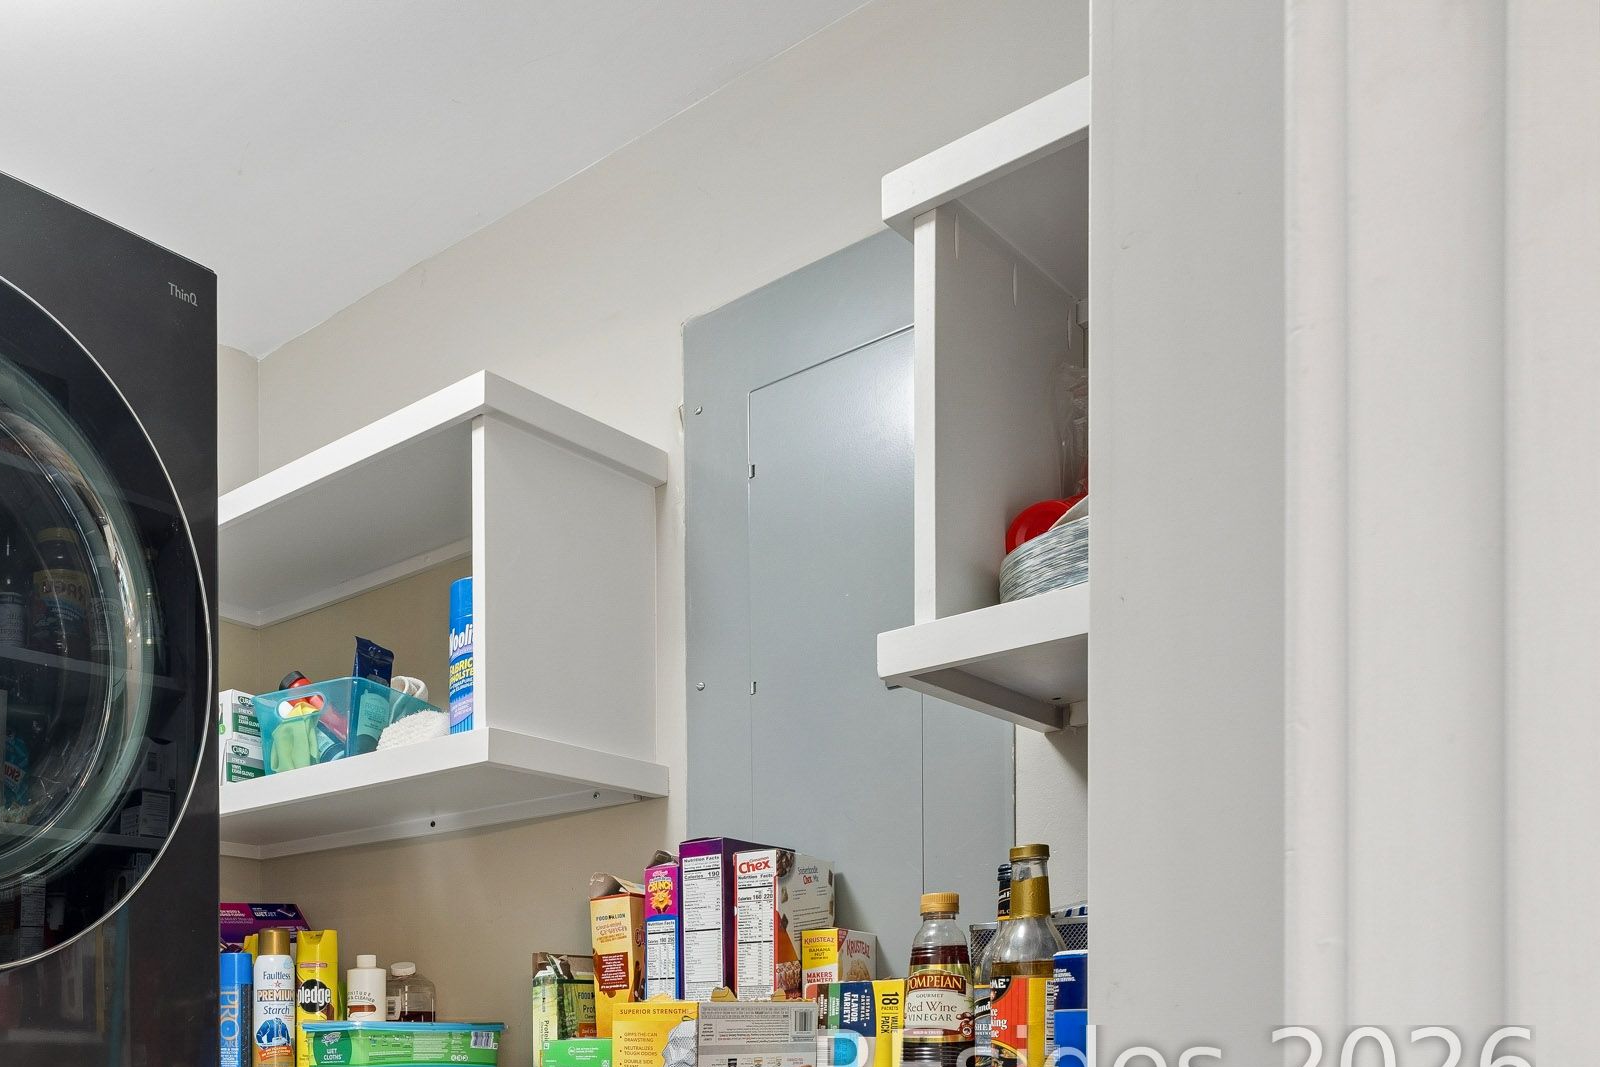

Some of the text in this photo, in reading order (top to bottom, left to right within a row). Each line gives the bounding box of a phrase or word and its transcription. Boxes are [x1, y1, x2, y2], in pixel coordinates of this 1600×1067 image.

[167, 281, 198, 307] ThinQ
[739, 860, 771, 874] Chex
[804, 937, 834, 945] KRUSTEAZ
[263, 971, 291, 980] Faultless
[297, 985, 331, 1007] pledge
[881, 992, 899, 1006] 18
[263, 1005, 290, 1015] Starch
[843, 992, 851, 1024] VARIETY
[851, 994, 859, 1022] FLAVOR
[907, 1001, 958, 1013] Red Wine
[908, 1013, 952, 1021] VINEGAR
[881, 1016, 890, 1034] PACK
